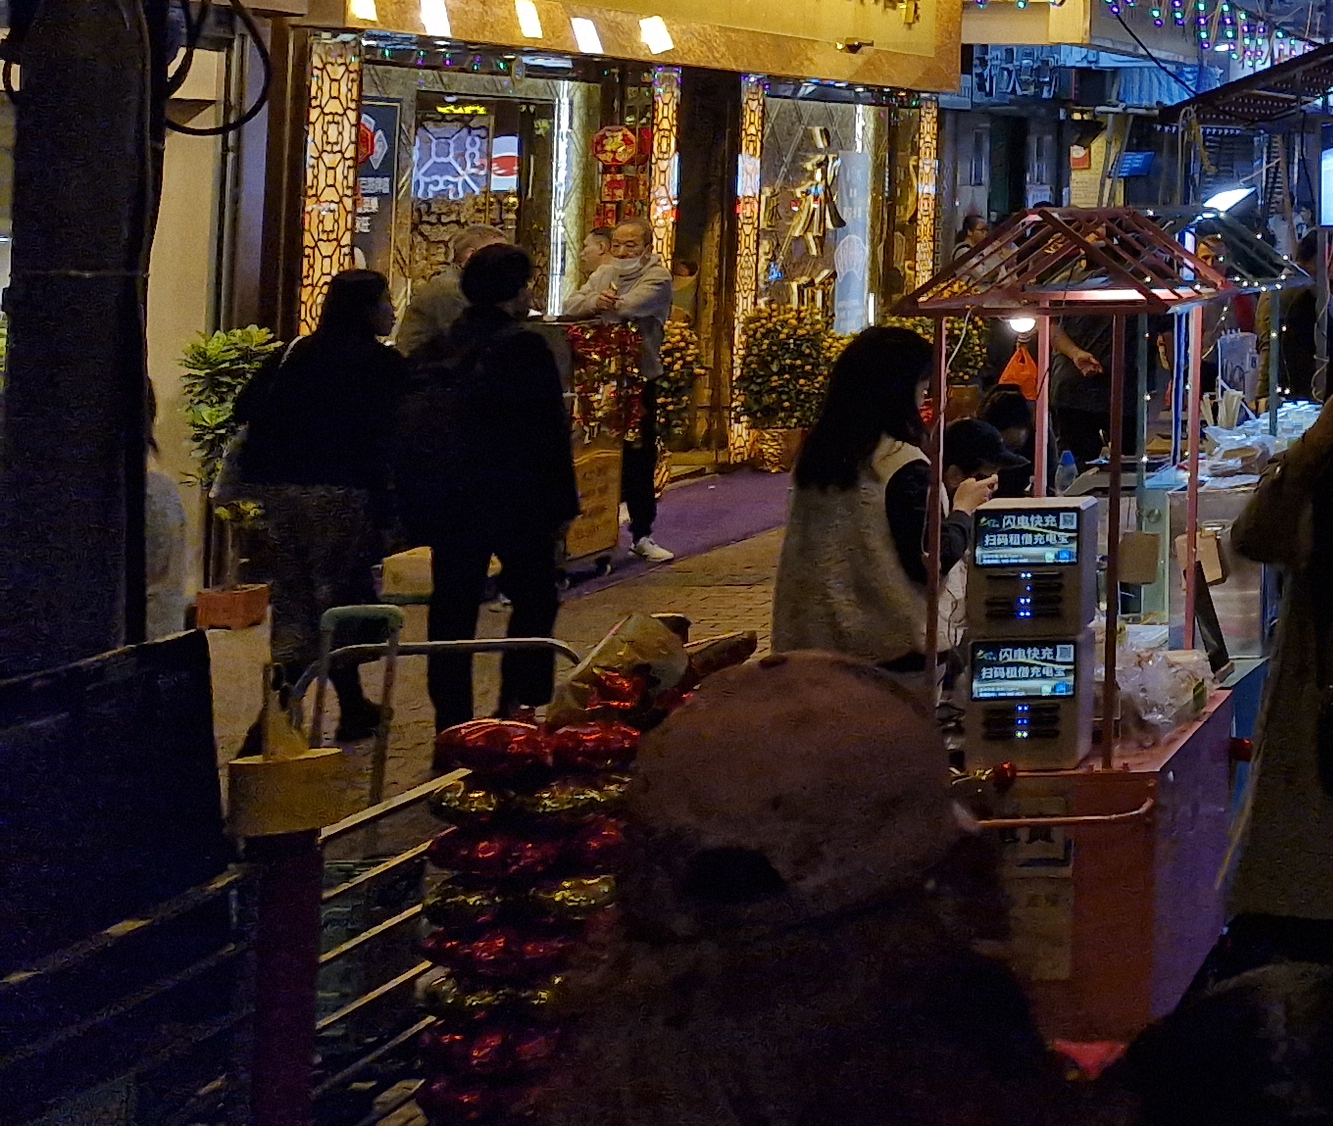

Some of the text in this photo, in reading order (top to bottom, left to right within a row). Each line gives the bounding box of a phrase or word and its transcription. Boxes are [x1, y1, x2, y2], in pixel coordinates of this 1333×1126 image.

[1002, 514, 1058, 529] 闪电快充
[984, 533, 1069, 547] 扫码租借充电宝
[998, 646, 1054, 661] 闪电快充
[980, 666, 1066, 680] 扫码租借充电宝
